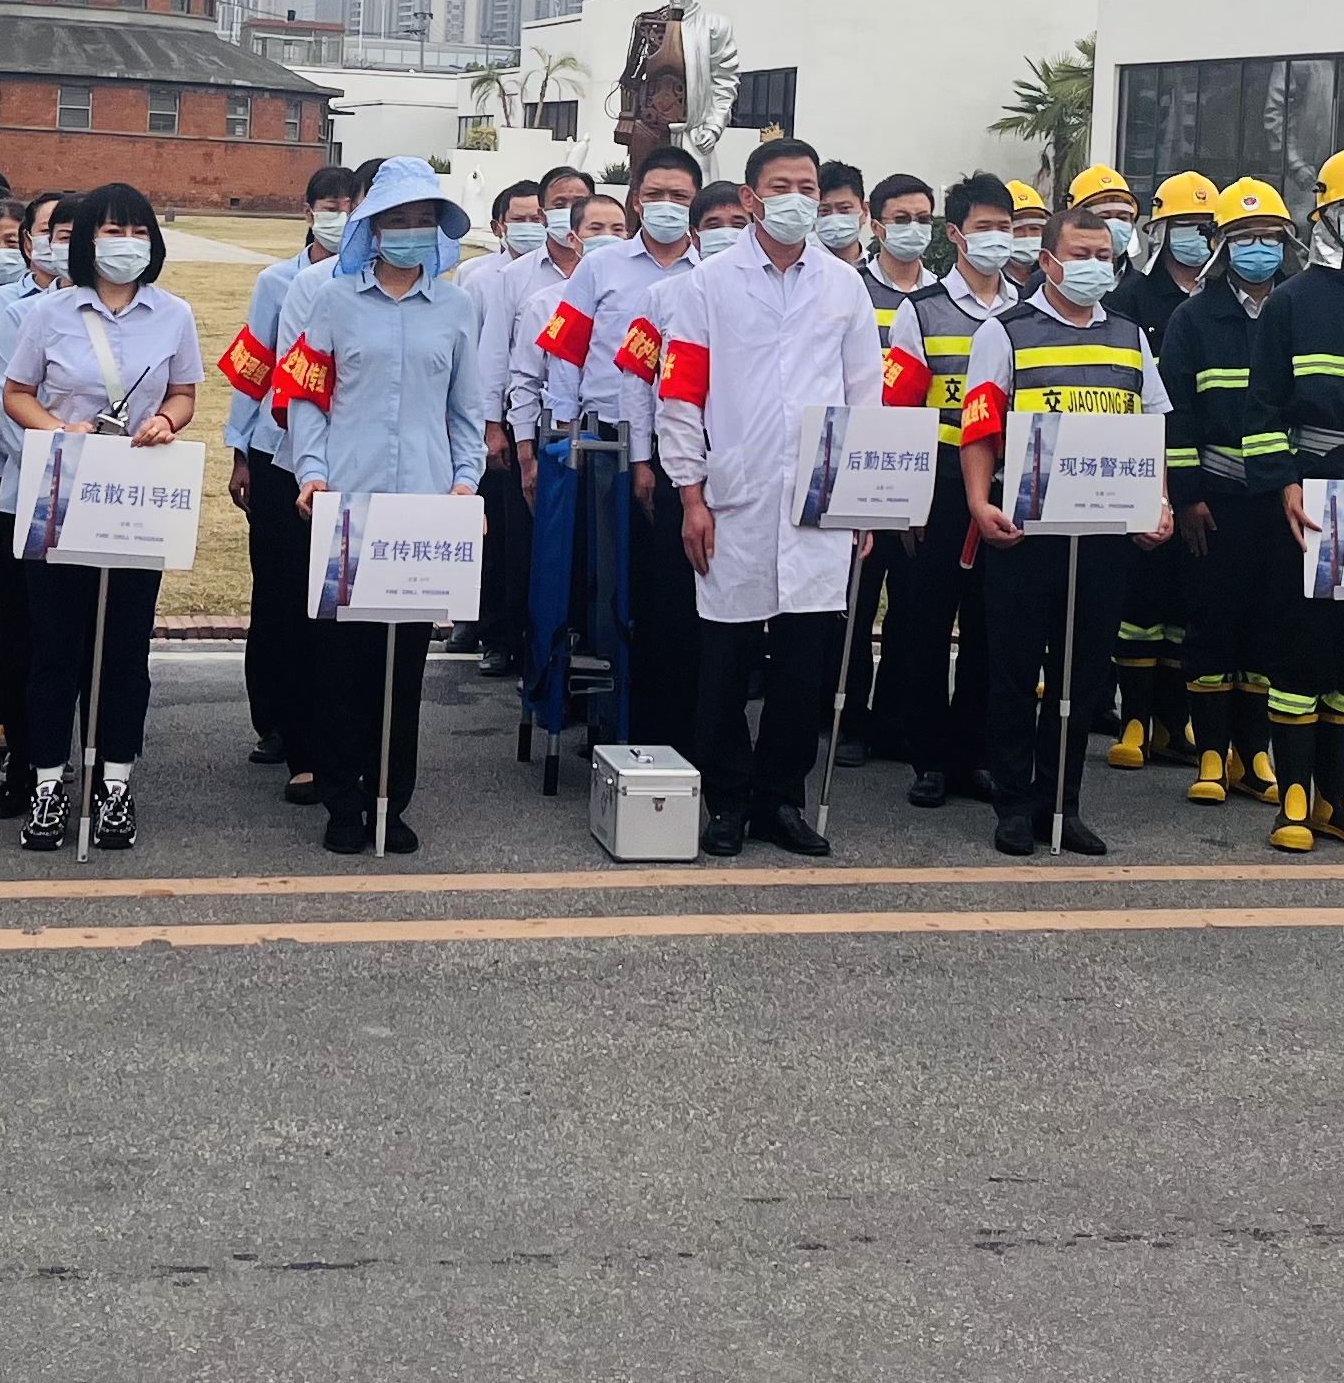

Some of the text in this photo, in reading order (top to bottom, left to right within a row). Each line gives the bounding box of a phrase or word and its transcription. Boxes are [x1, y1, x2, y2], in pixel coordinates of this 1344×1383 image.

[944, 378, 962, 403] 交
[1043, 389, 1063, 413] 交
[1068, 390, 1121, 414] JIAOTONG
[846, 450, 930, 472] 后勤医疗组
[1059, 457, 1156, 478] 现场警戒组
[80, 482, 191, 510] 疏散引导组
[370, 539, 474, 563] 宣传联络组
